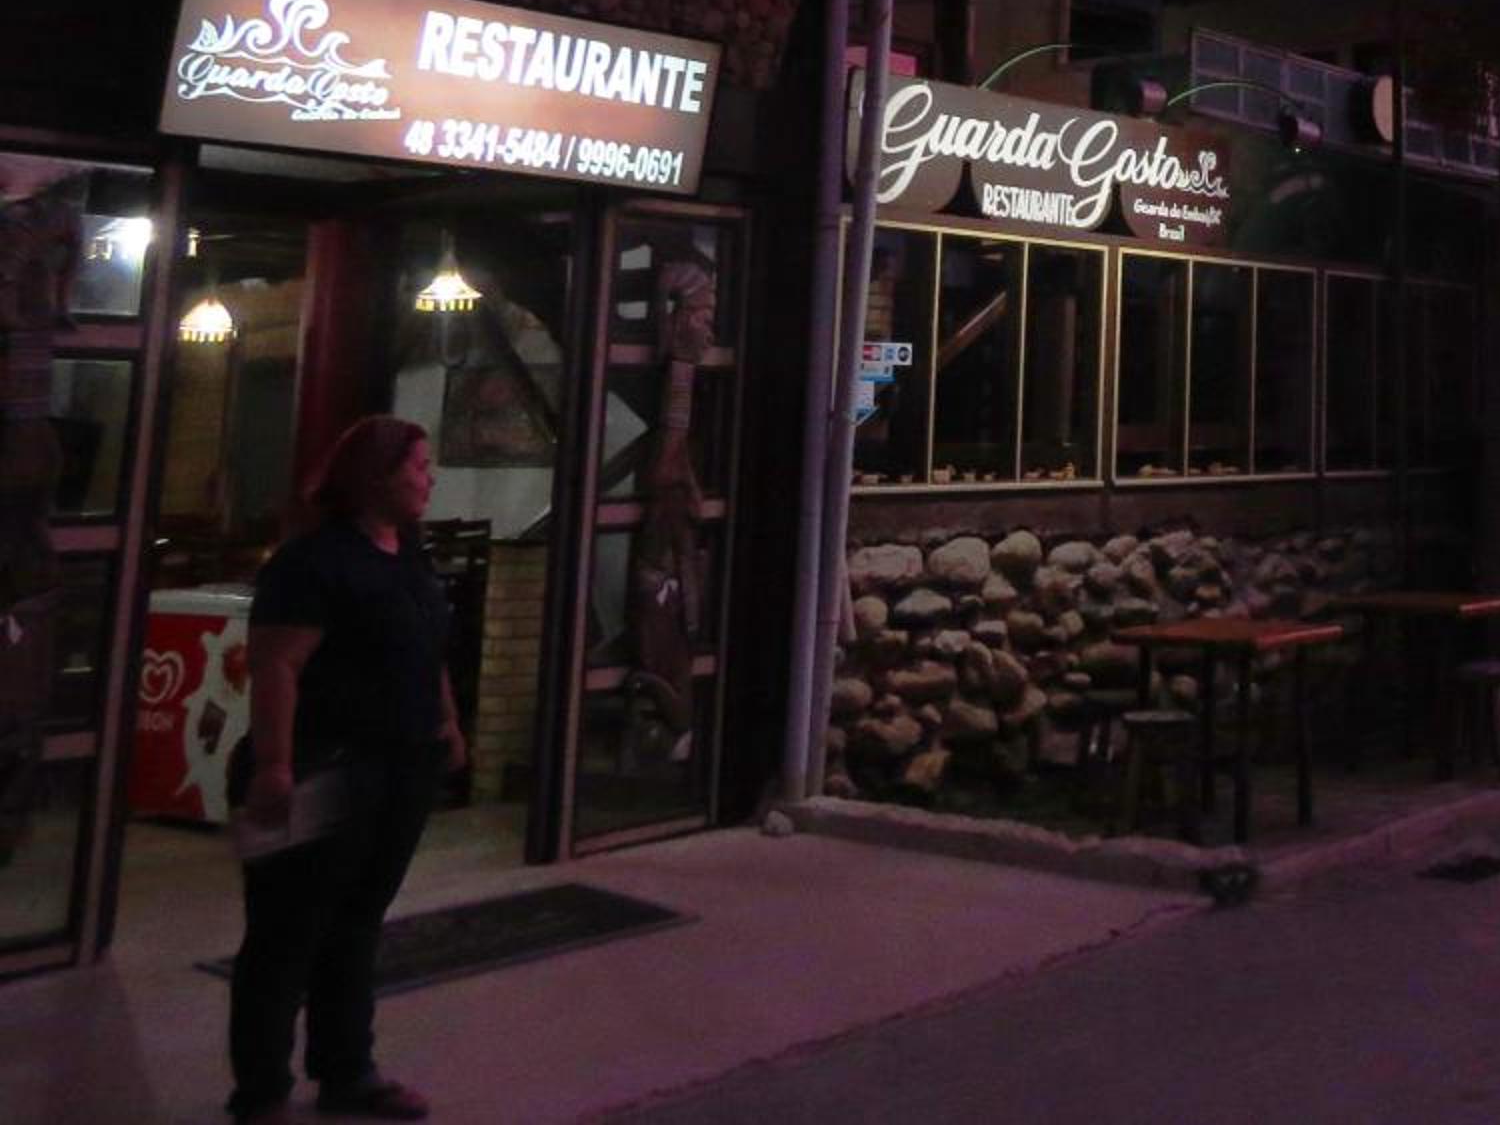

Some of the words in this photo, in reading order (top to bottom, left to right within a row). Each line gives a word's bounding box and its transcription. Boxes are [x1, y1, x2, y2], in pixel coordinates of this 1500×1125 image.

[417, 10, 707, 113] RESTAURANTE
[404, 120, 434, 155] 48
[437, 119, 563, 169] 3341-5484
[576, 137, 685, 186] 9996-0691
[875, 82, 1060, 203] Guarda
[983, 183, 1076, 227] RESTAURANTE
